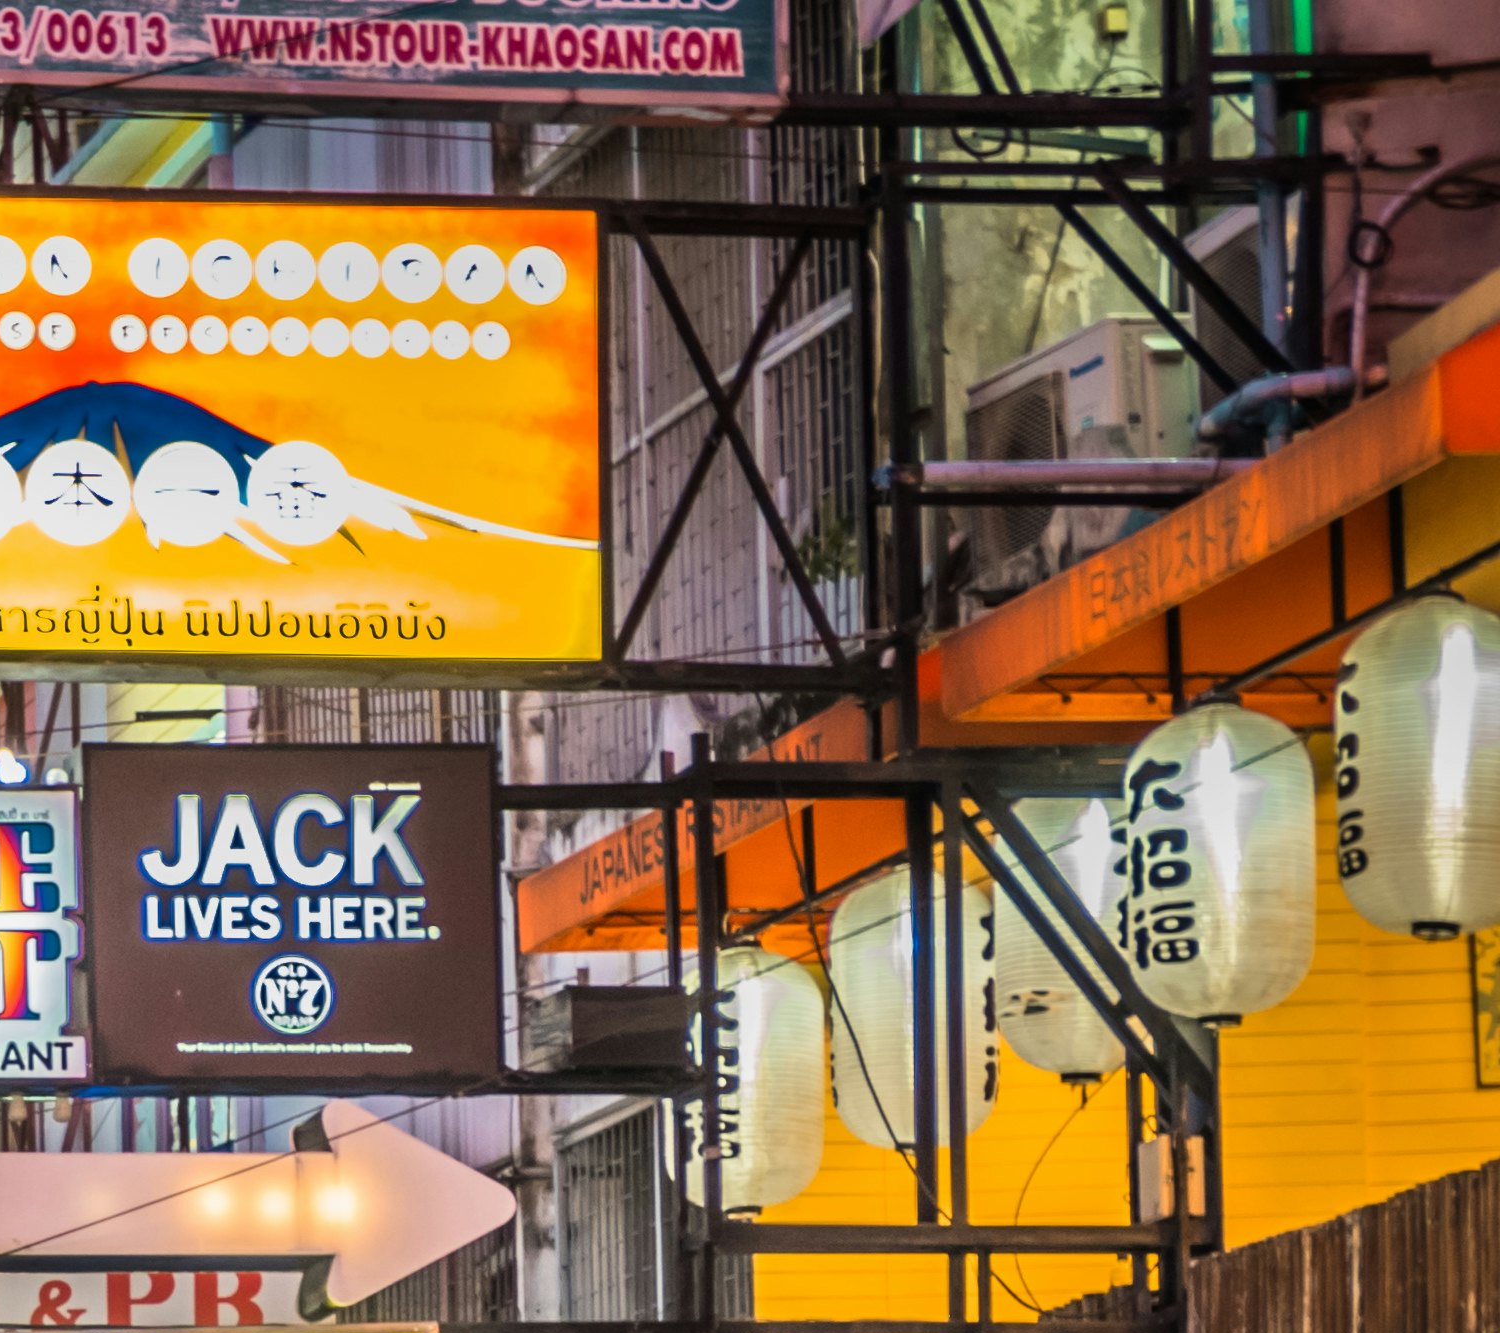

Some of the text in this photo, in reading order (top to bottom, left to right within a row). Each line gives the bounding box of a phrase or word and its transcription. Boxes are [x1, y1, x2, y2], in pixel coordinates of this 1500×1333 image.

[209, 17, 742, 73] WWW.NSTOUR-KHAOSAN.COM
[140, 793, 425, 888] JACK
[145, 896, 442, 941] LIVES HERE.
